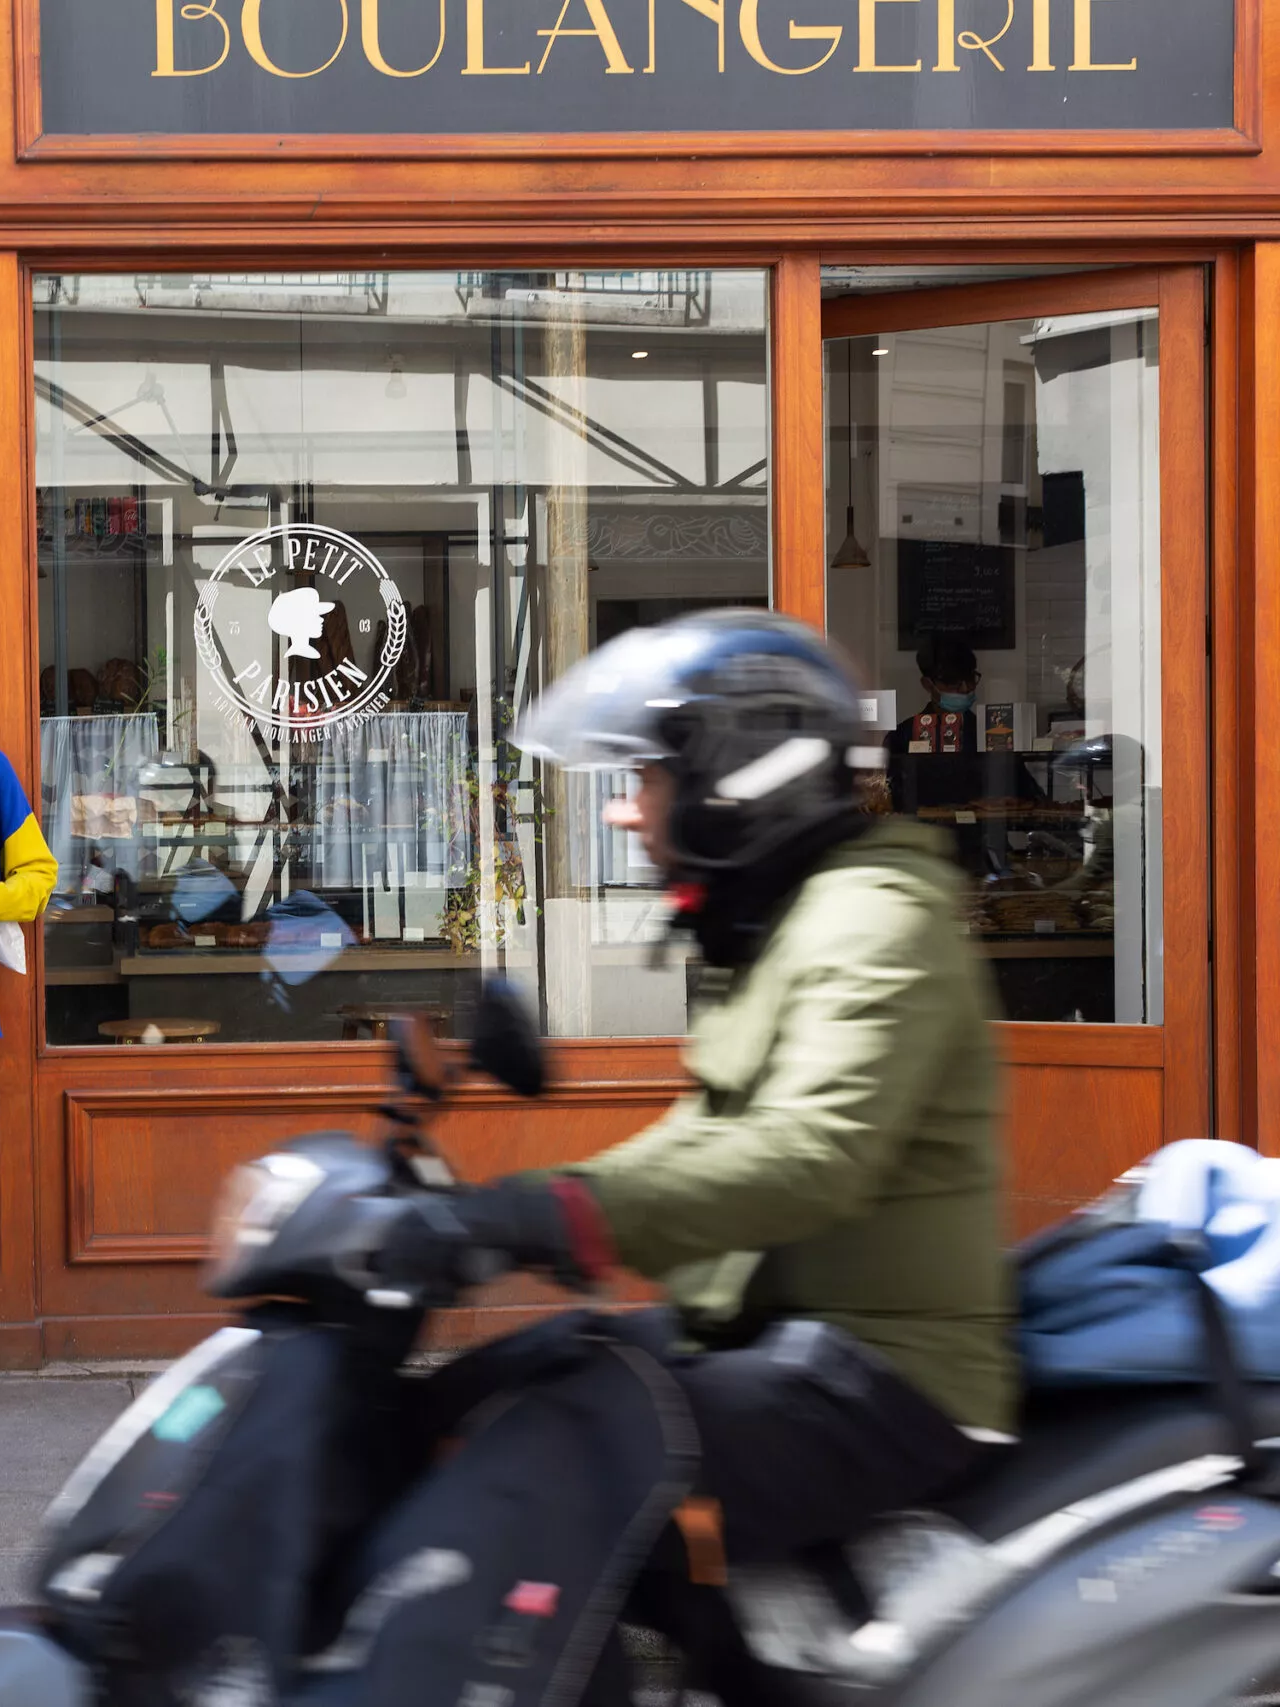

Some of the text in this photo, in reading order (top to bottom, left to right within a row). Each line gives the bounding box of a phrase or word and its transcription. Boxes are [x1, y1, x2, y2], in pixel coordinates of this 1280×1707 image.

[150, 0, 1138, 79] BOULANGERIE
[236, 538, 364, 587] LE PETIT
[228, 621, 240, 635] 75
[359, 619, 371, 633] 03
[233, 657, 368, 714] PARISIEN
[211, 692, 391, 744] ARTISAN BOULANGER PATISSIER
